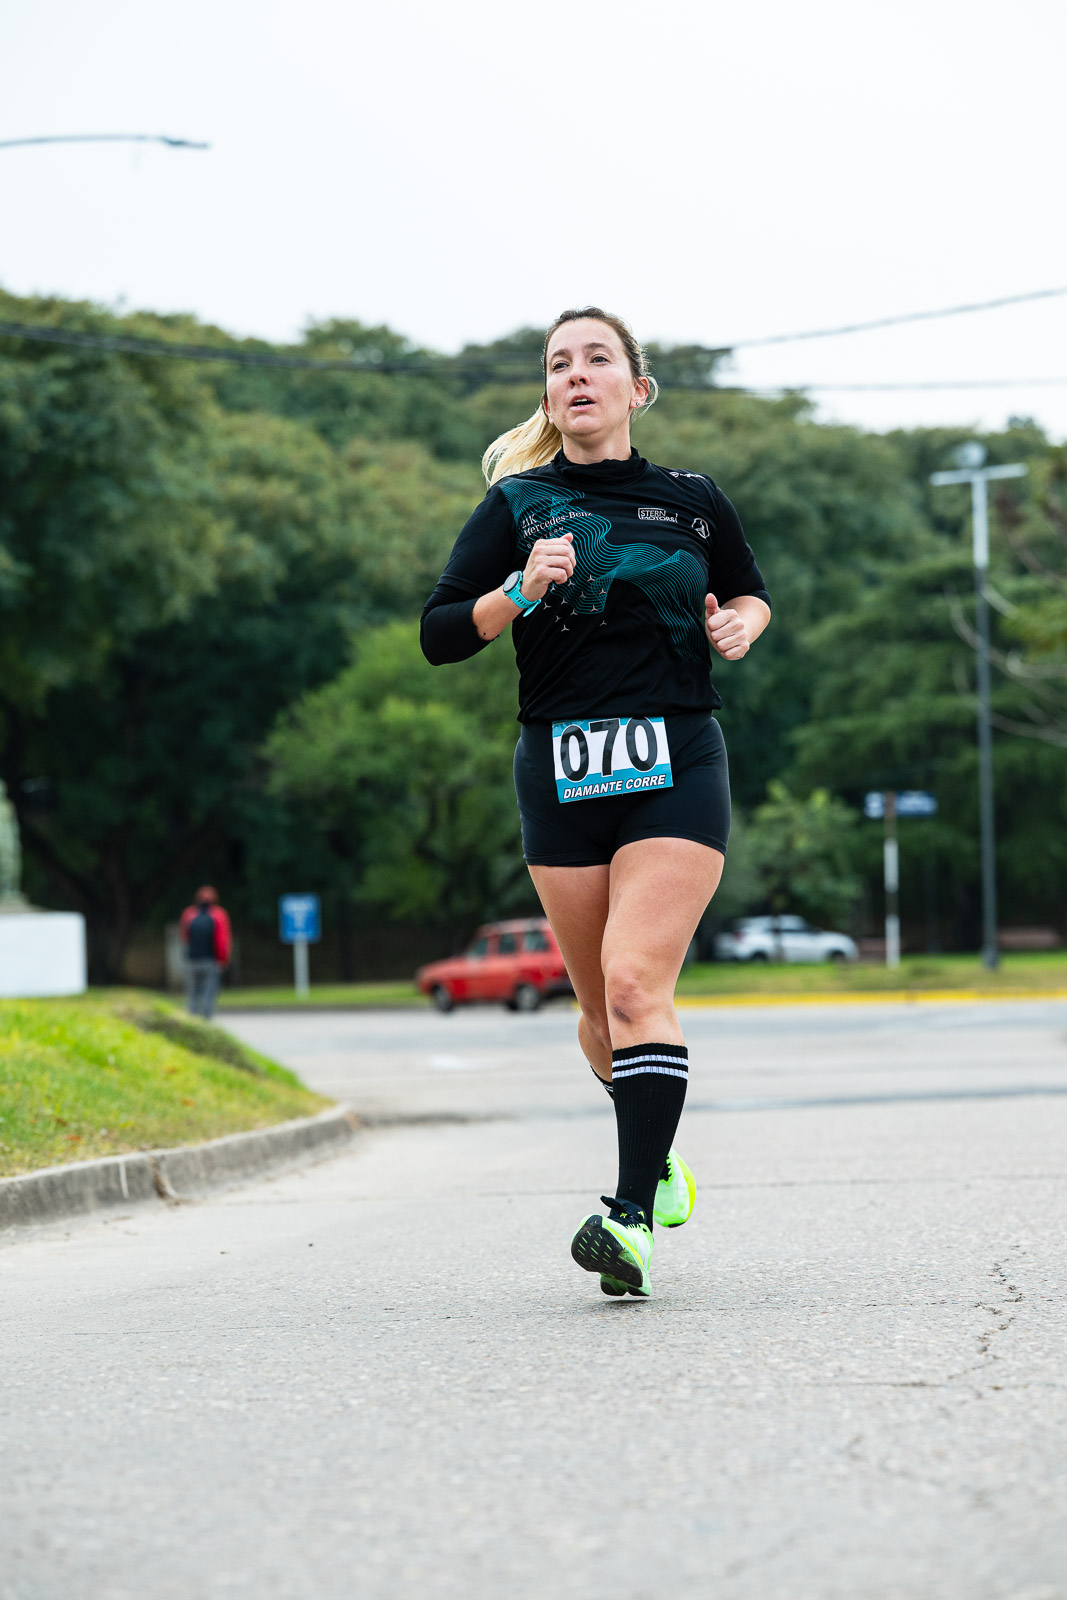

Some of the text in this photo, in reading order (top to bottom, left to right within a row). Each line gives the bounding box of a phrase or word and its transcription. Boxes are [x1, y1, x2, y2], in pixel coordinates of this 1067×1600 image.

[523, 511, 593, 539] Mercedes-Benz
[640, 509, 666, 517] STERN
[560, 717, 658, 783] 070
[563, 774, 666, 799] DIAMANTE CORRE
